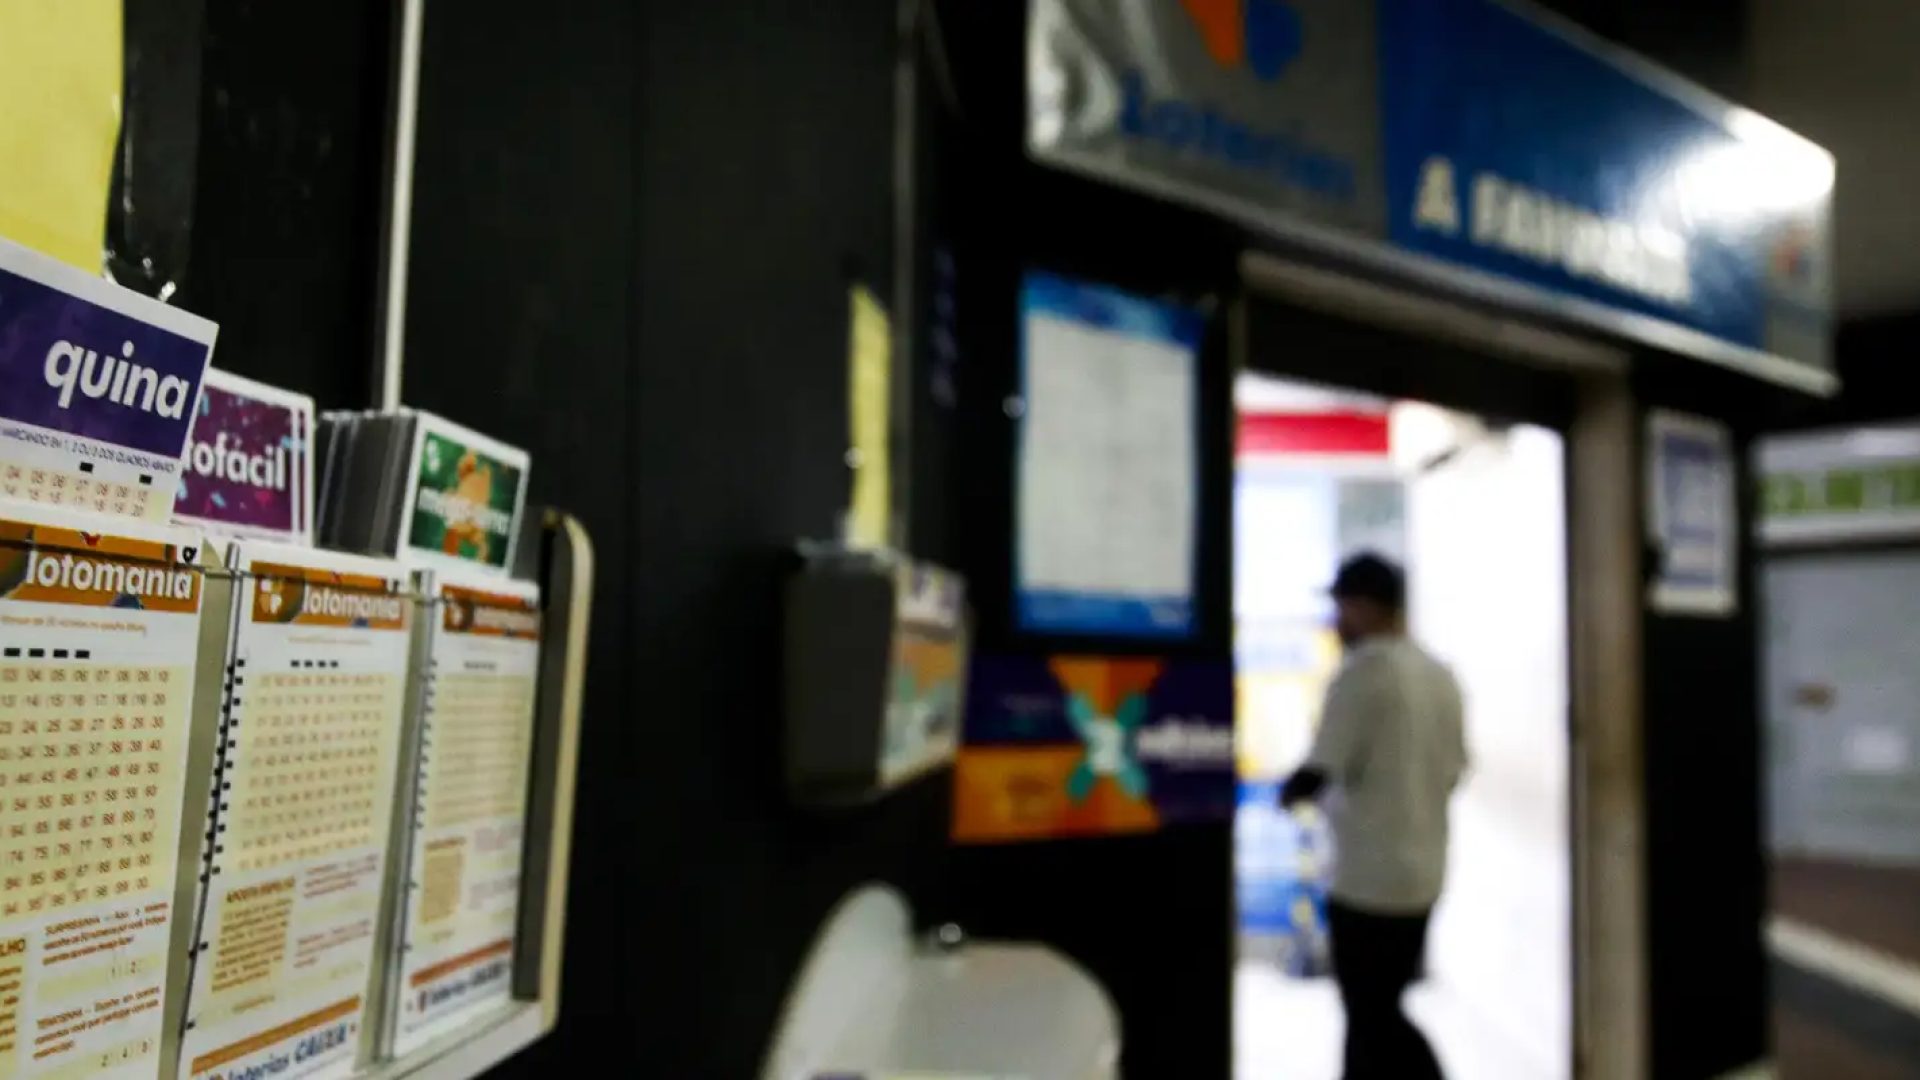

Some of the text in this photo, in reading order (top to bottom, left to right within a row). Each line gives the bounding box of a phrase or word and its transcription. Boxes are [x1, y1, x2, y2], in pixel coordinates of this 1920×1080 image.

[1413, 154, 1459, 234] A
[43, 339, 190, 420] quina
[25, 550, 193, 600] lotomania
